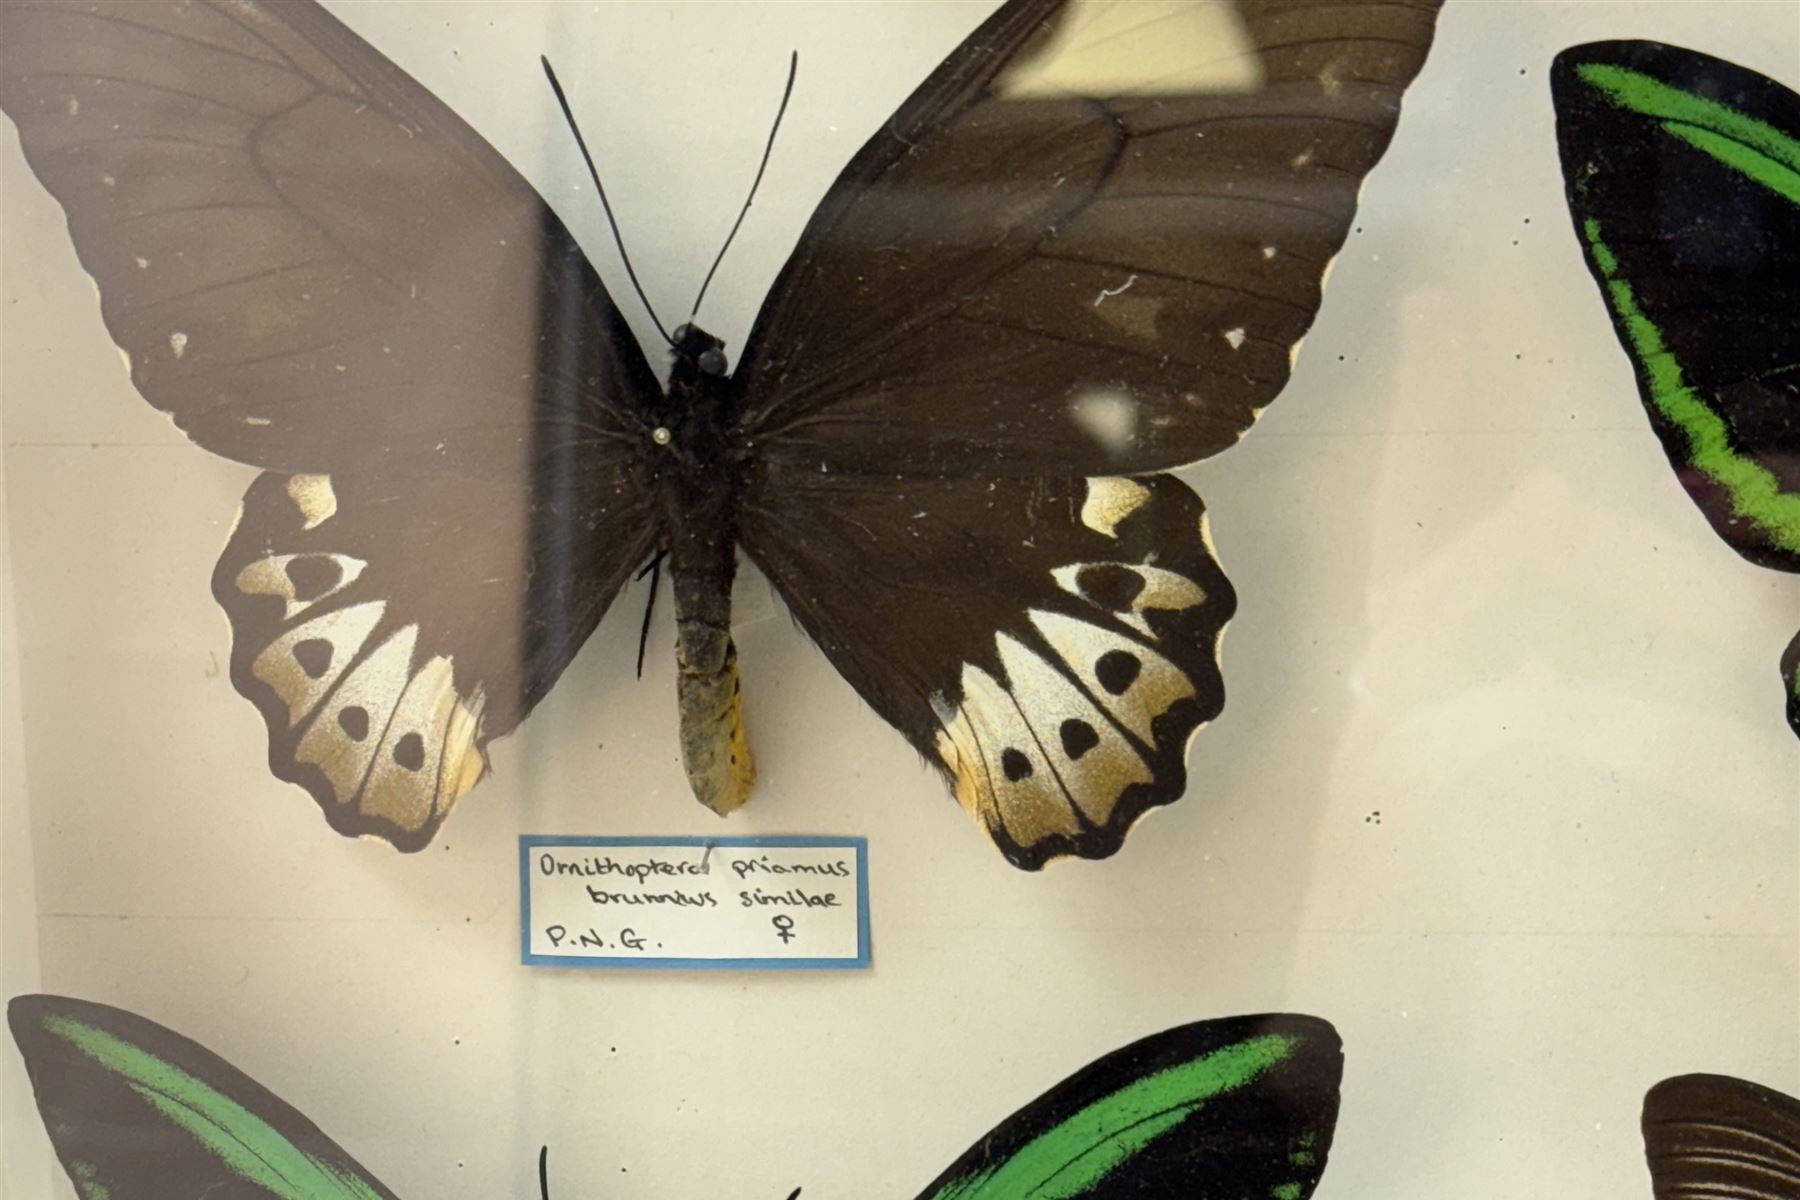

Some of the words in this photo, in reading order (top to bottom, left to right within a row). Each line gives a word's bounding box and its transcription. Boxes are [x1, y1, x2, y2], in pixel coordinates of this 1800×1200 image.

[731, 856, 850, 878] priamus
[739, 887, 843, 907] similae
[545, 925, 662, 950] P.N.G.
